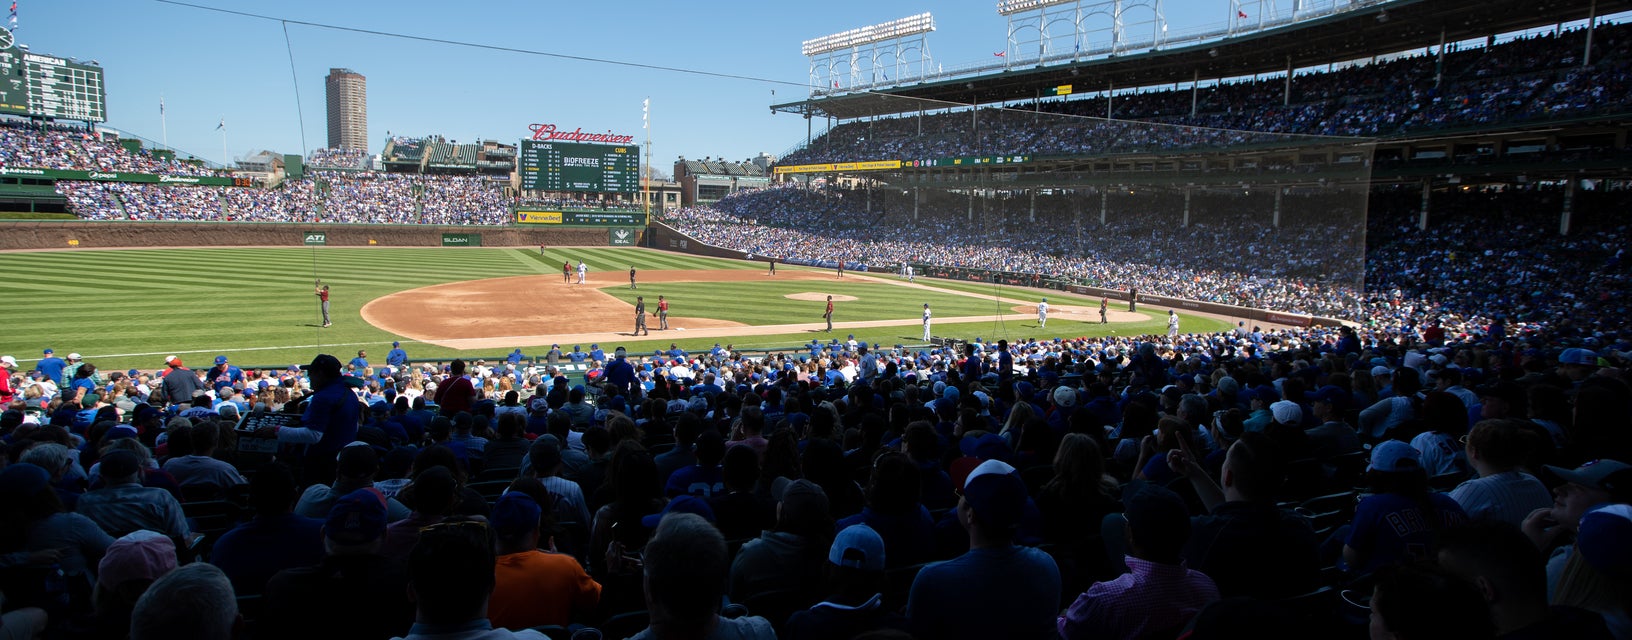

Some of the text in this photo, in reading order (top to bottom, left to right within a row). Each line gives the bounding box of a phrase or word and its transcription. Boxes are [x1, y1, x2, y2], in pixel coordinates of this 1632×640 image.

[23, 53, 67, 66] AMERICAN
[528, 124, 634, 143] Budweiser
[563, 156, 599, 165] BIOFREEZE
